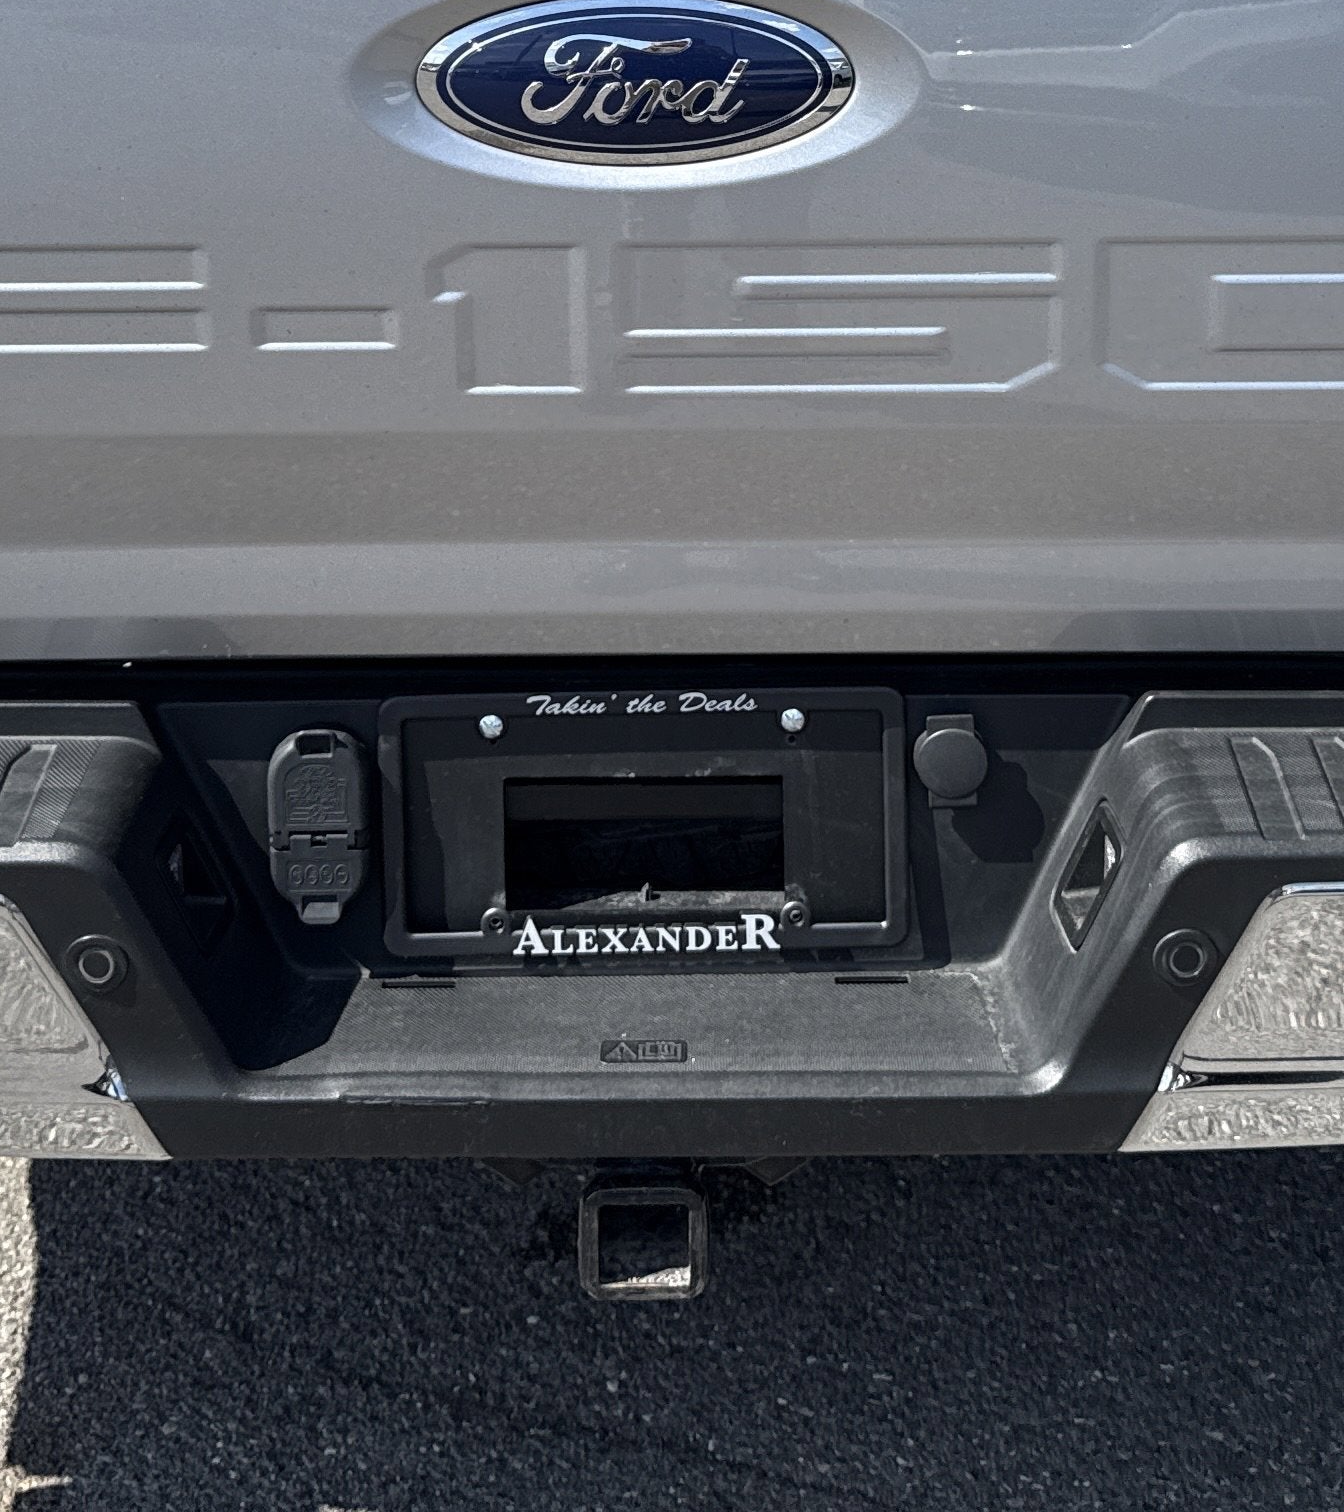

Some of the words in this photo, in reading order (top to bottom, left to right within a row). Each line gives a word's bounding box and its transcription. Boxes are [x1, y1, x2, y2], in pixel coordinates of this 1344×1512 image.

[520, 33, 750, 126] Ford
[526, 694, 618, 716] Takin'
[625, 694, 666, 713] the
[678, 692, 758, 713] Deals
[513, 913, 781, 955] ALEXANDER
